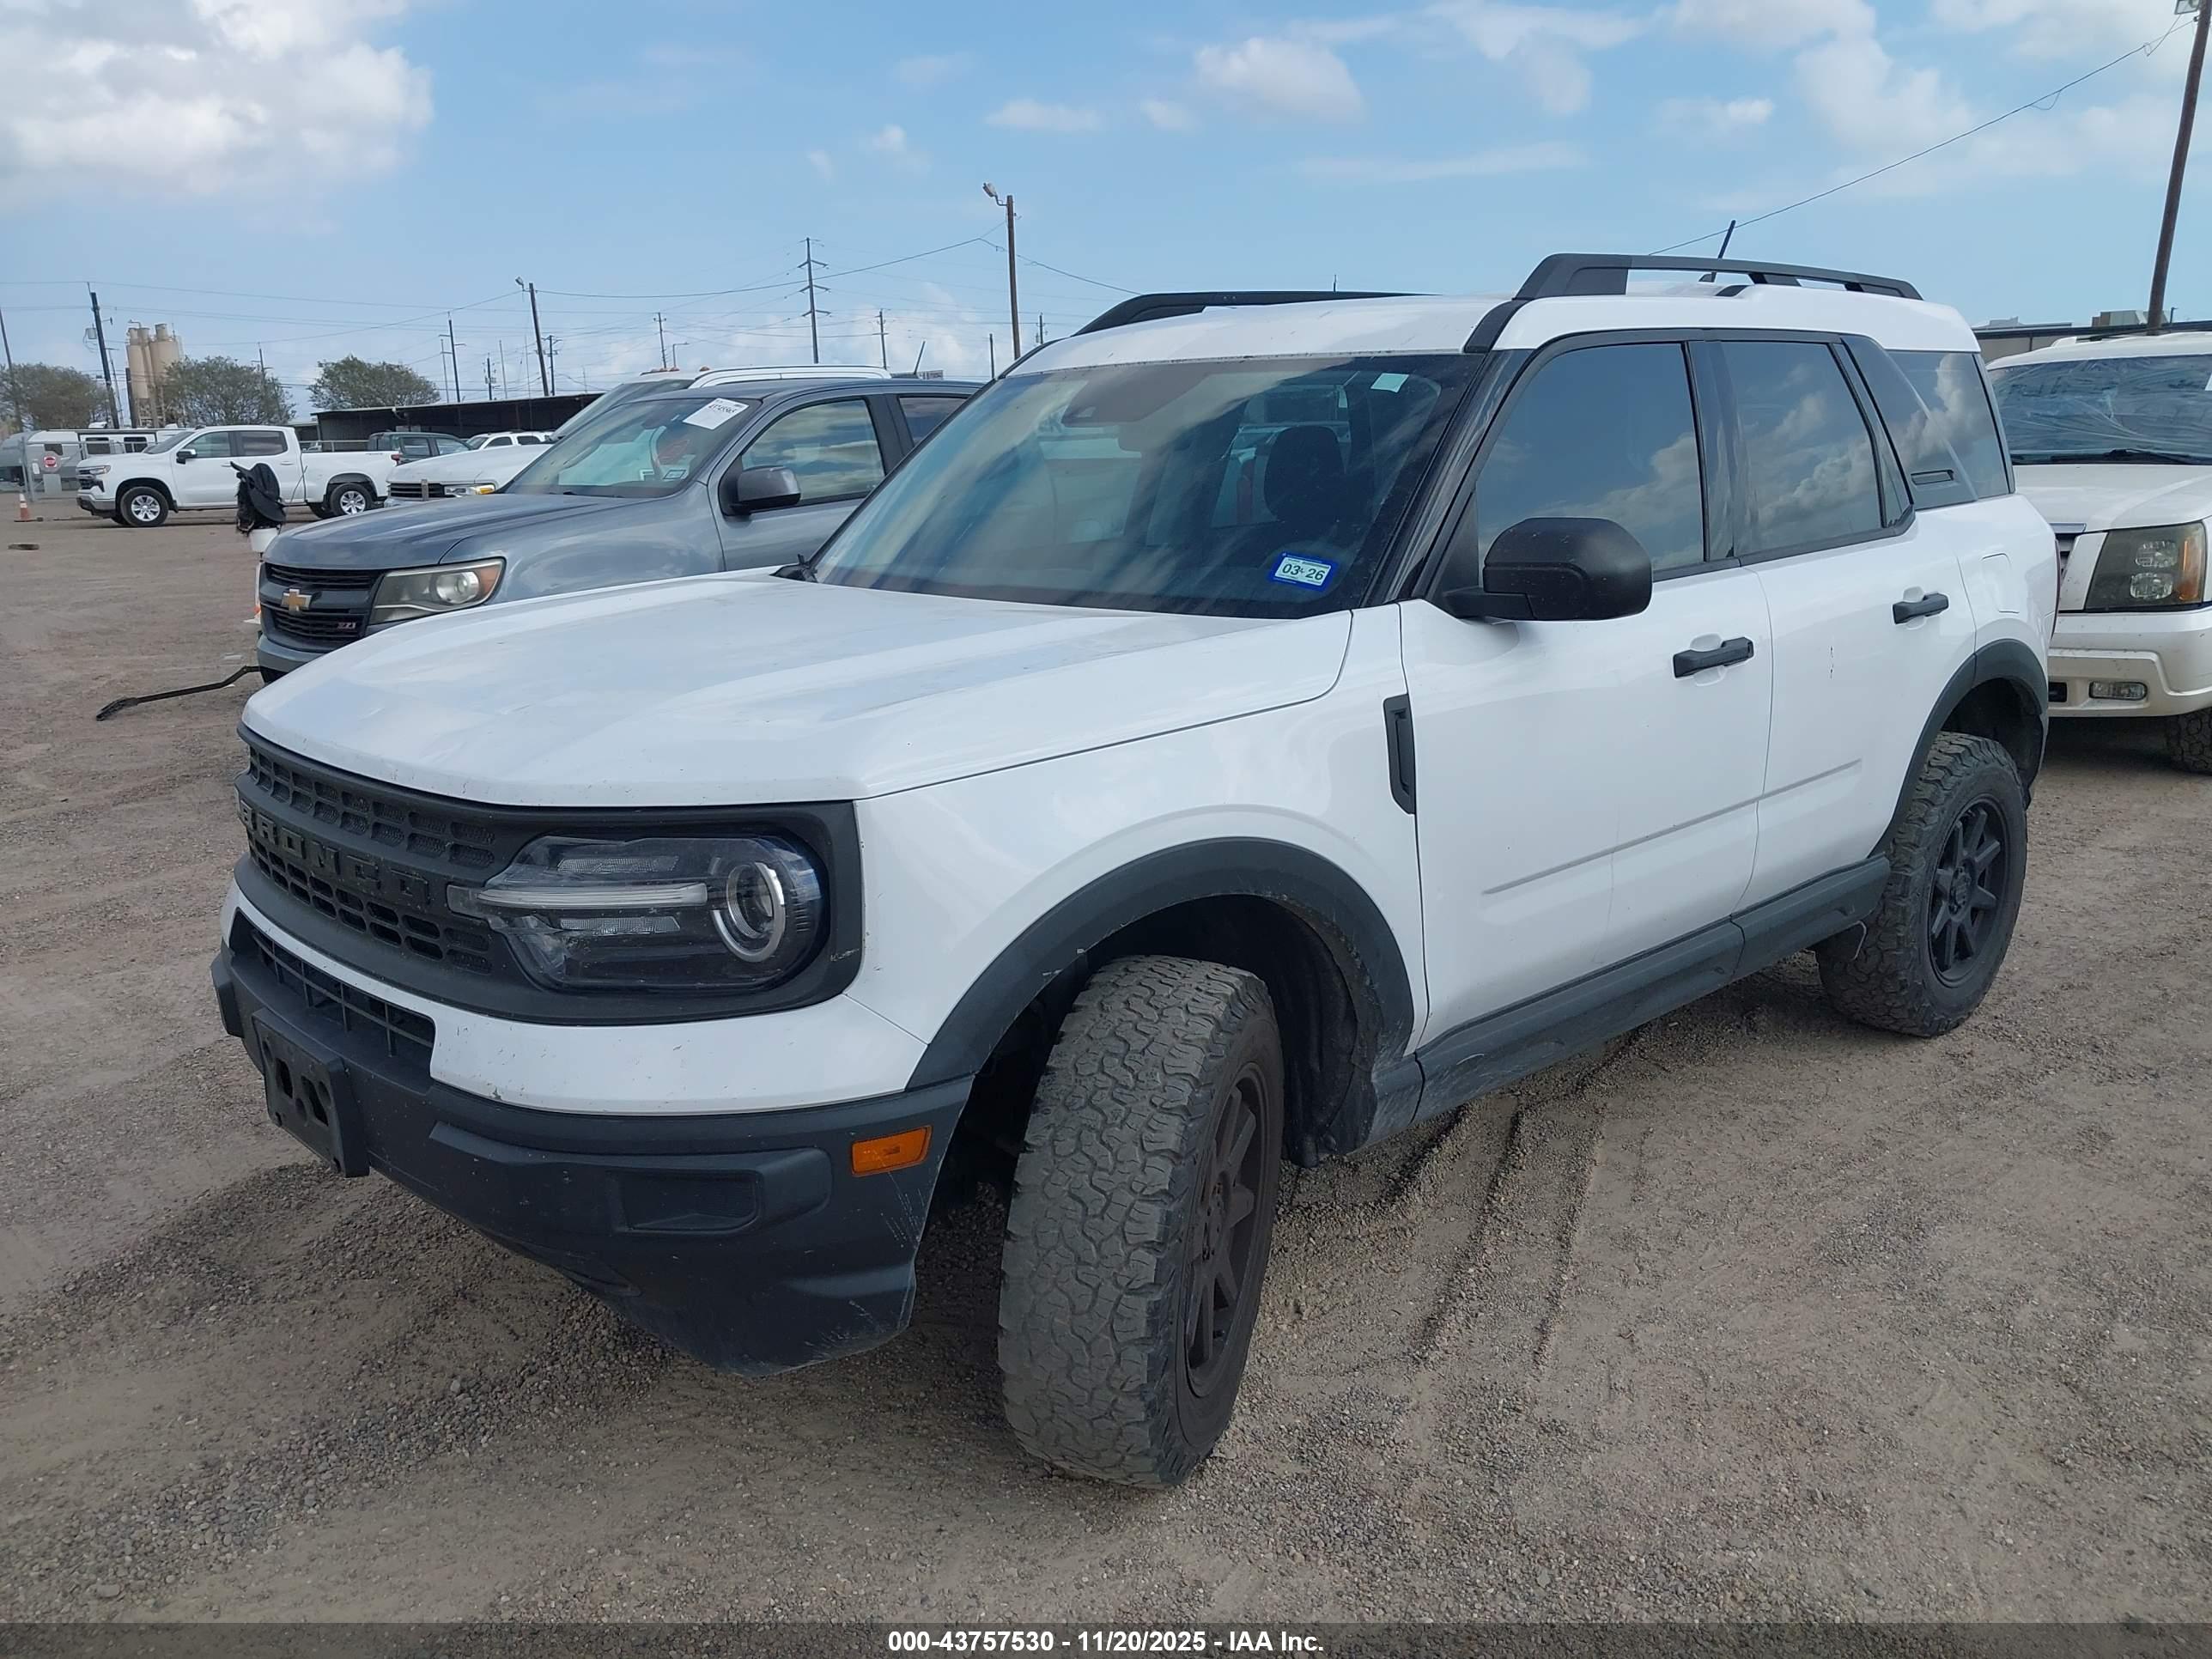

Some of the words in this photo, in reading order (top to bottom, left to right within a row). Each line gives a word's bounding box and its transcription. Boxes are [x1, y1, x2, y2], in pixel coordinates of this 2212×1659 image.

[1282, 563, 1301, 575] 03
[1305, 568, 1325, 580] 26
[240, 799, 431, 906] BRONCO
